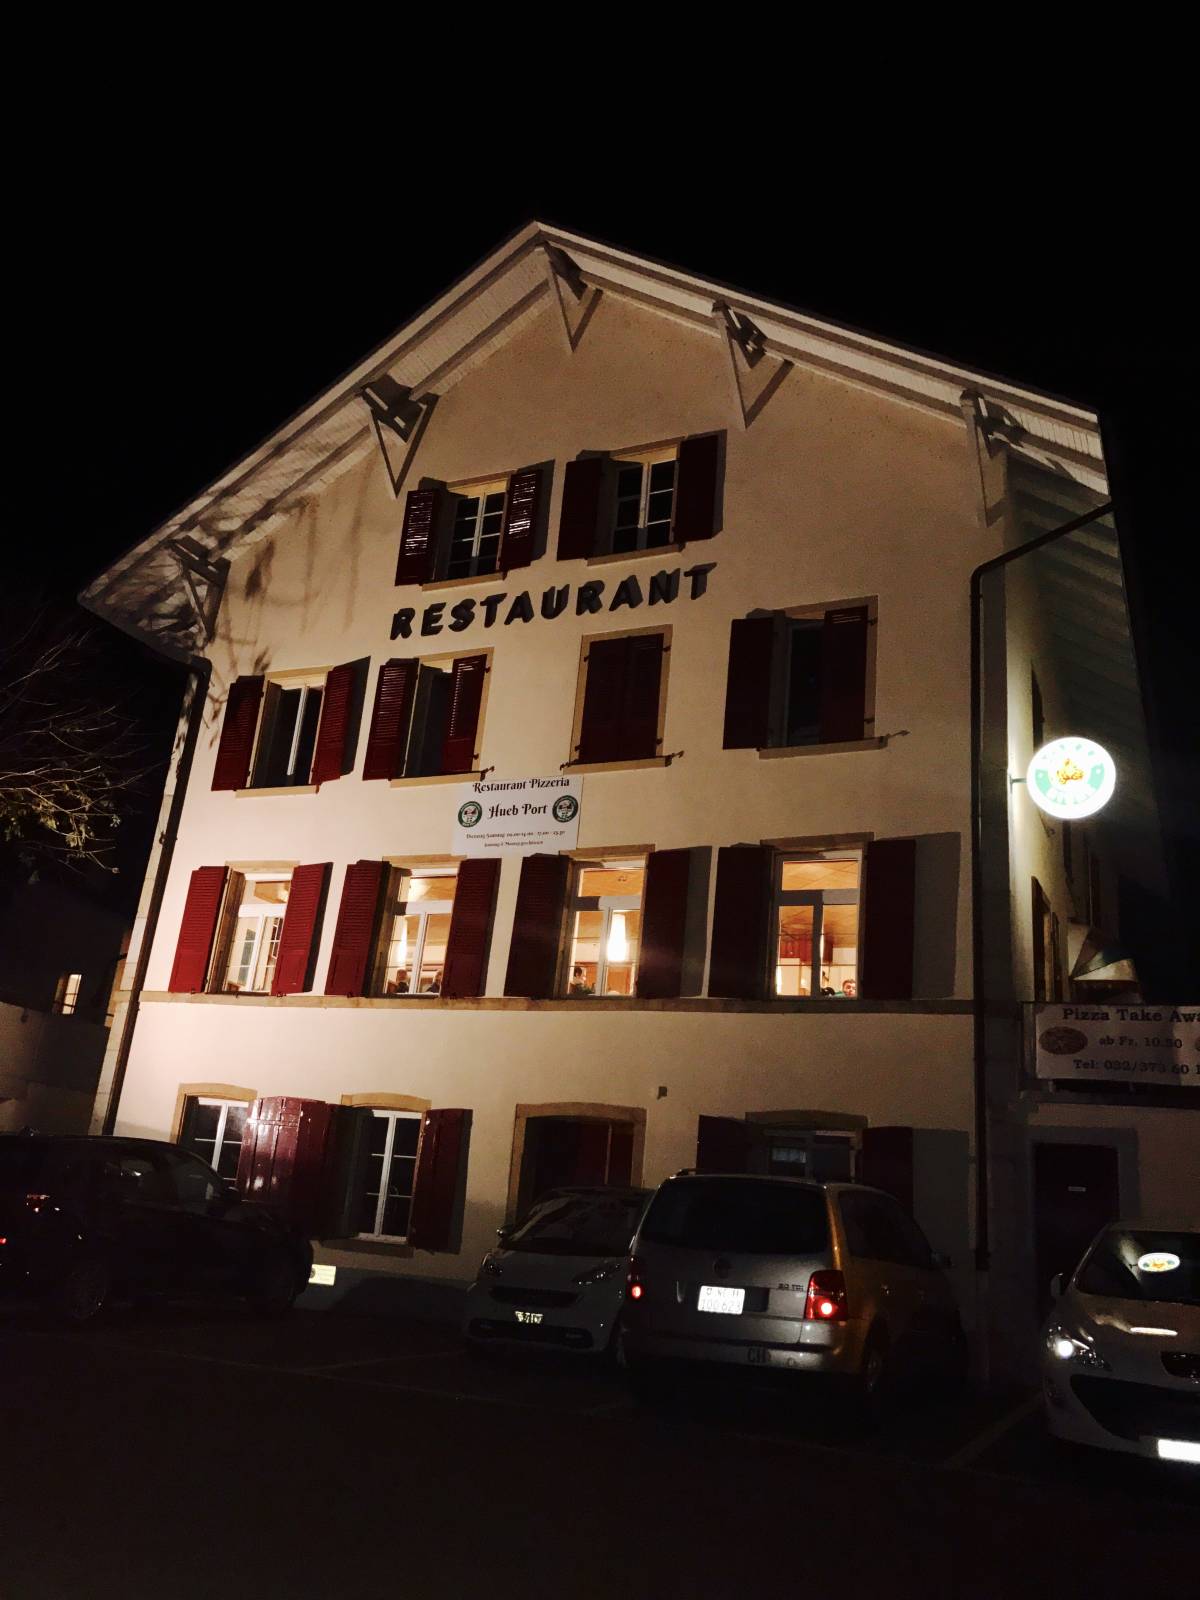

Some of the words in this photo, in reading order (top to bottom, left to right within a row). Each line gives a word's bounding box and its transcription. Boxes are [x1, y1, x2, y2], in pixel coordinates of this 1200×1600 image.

[390, 562, 717, 640] RESTAURANT
[472, 781, 526, 794] Restaurant
[529, 777, 570, 790] Pizzeria
[521, 803, 548, 816] Port
[1062, 1007, 1110, 1021] Pizza
[1116, 1008, 1163, 1022] Take
[1099, 1034, 1114, 1046] ab
[1073, 1058, 1098, 1070] Tel:
